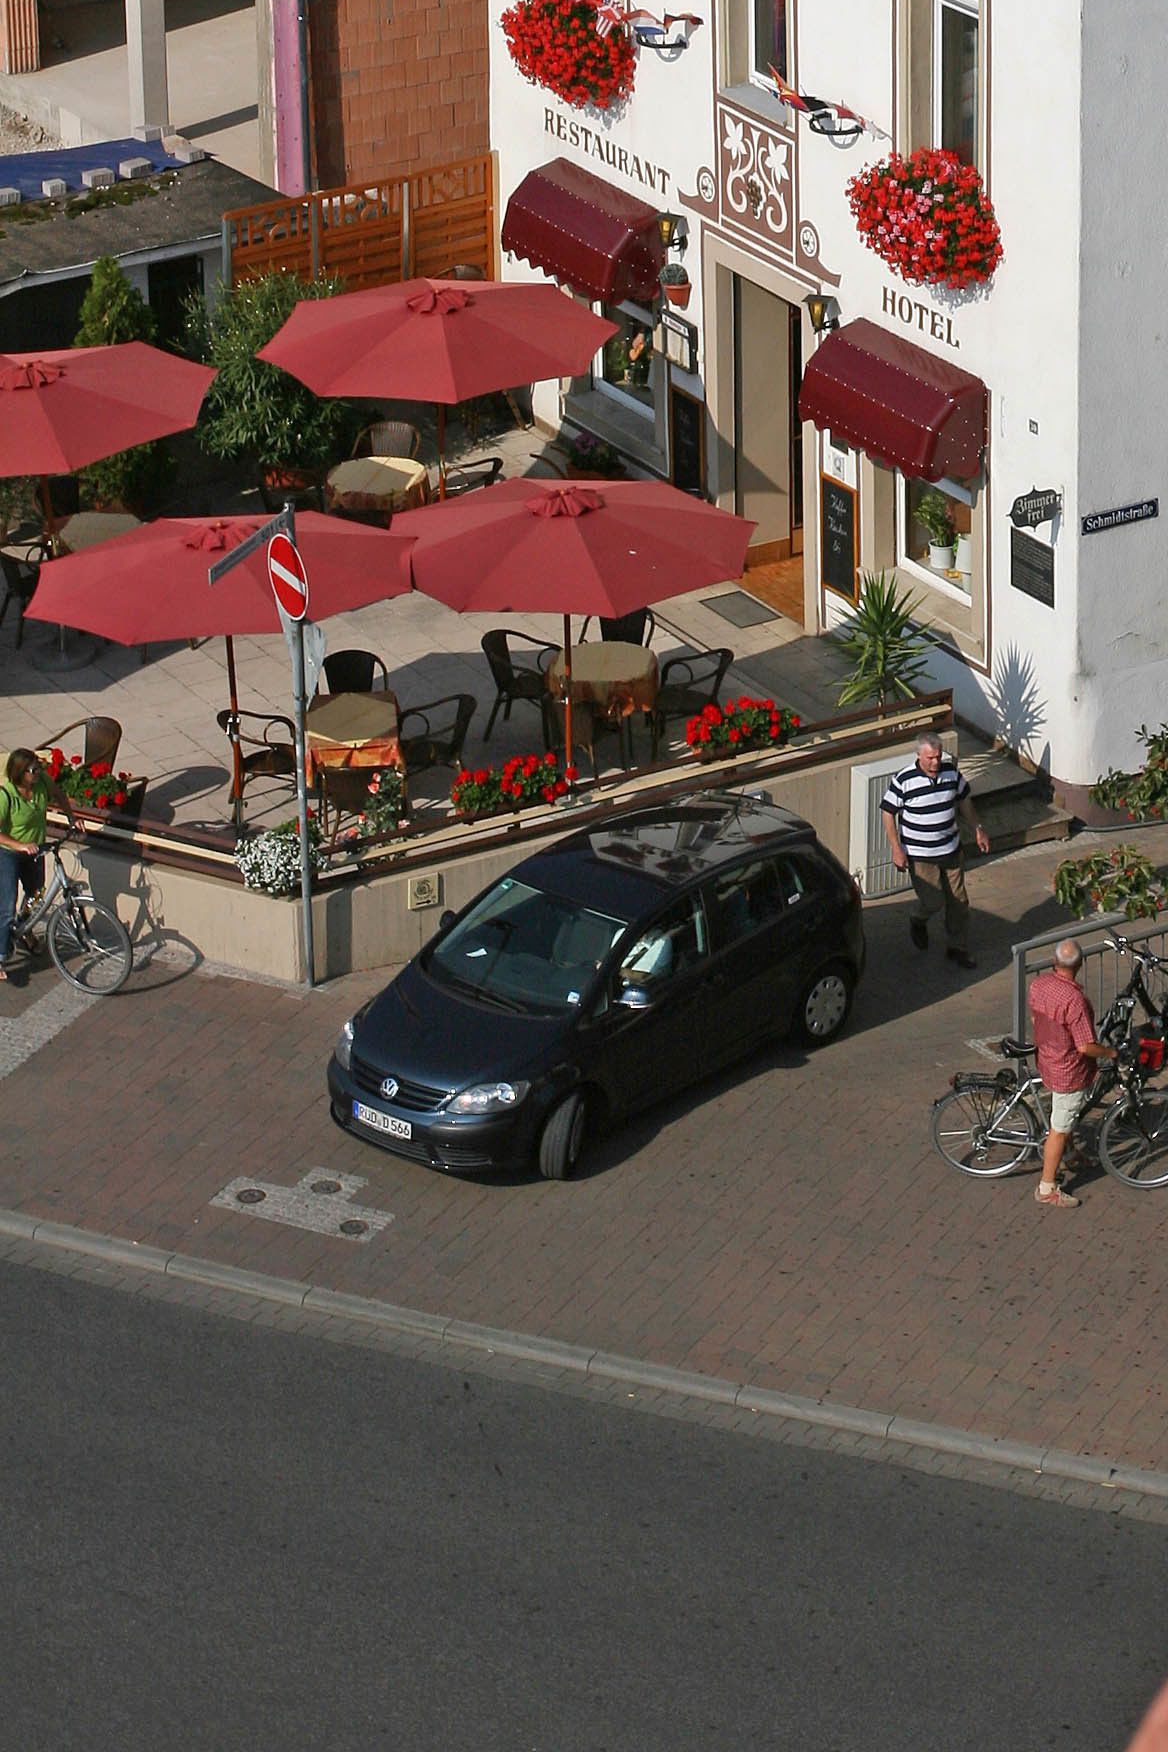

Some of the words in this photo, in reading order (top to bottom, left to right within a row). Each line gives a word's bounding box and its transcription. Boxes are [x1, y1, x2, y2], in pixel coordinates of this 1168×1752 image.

[544, 107, 671, 196] RESTAURANT
[882, 285, 960, 349] HOTEL
[1015, 494, 1055, 514] Zimmer
[1086, 503, 1154, 531] Schmidtstraße
